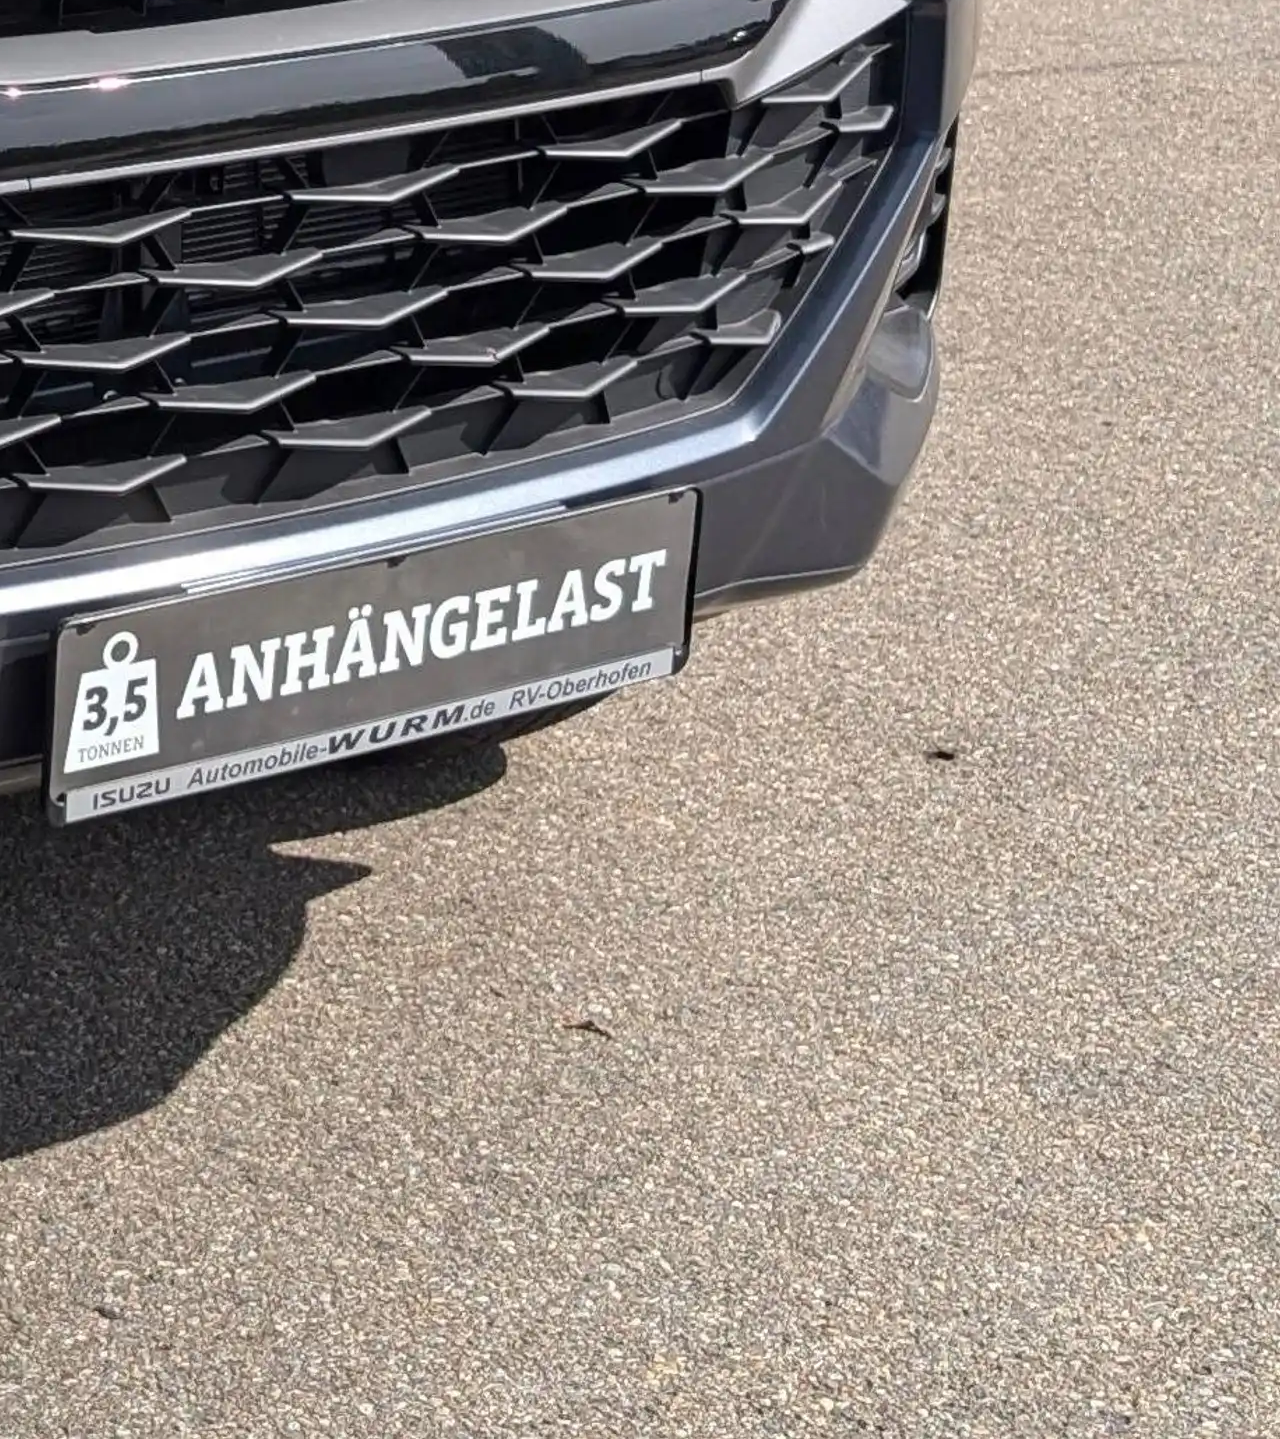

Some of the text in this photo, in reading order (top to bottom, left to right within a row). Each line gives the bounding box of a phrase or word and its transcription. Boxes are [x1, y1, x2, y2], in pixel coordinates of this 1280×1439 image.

[176, 549, 667, 720] ANHÄNGELAST
[77, 735, 145, 763] TONNEN
[82, 676, 149, 736] 3,5
[93, 660, 652, 810] ISUZU Automobile-WURM.de RV-Oberhofen
